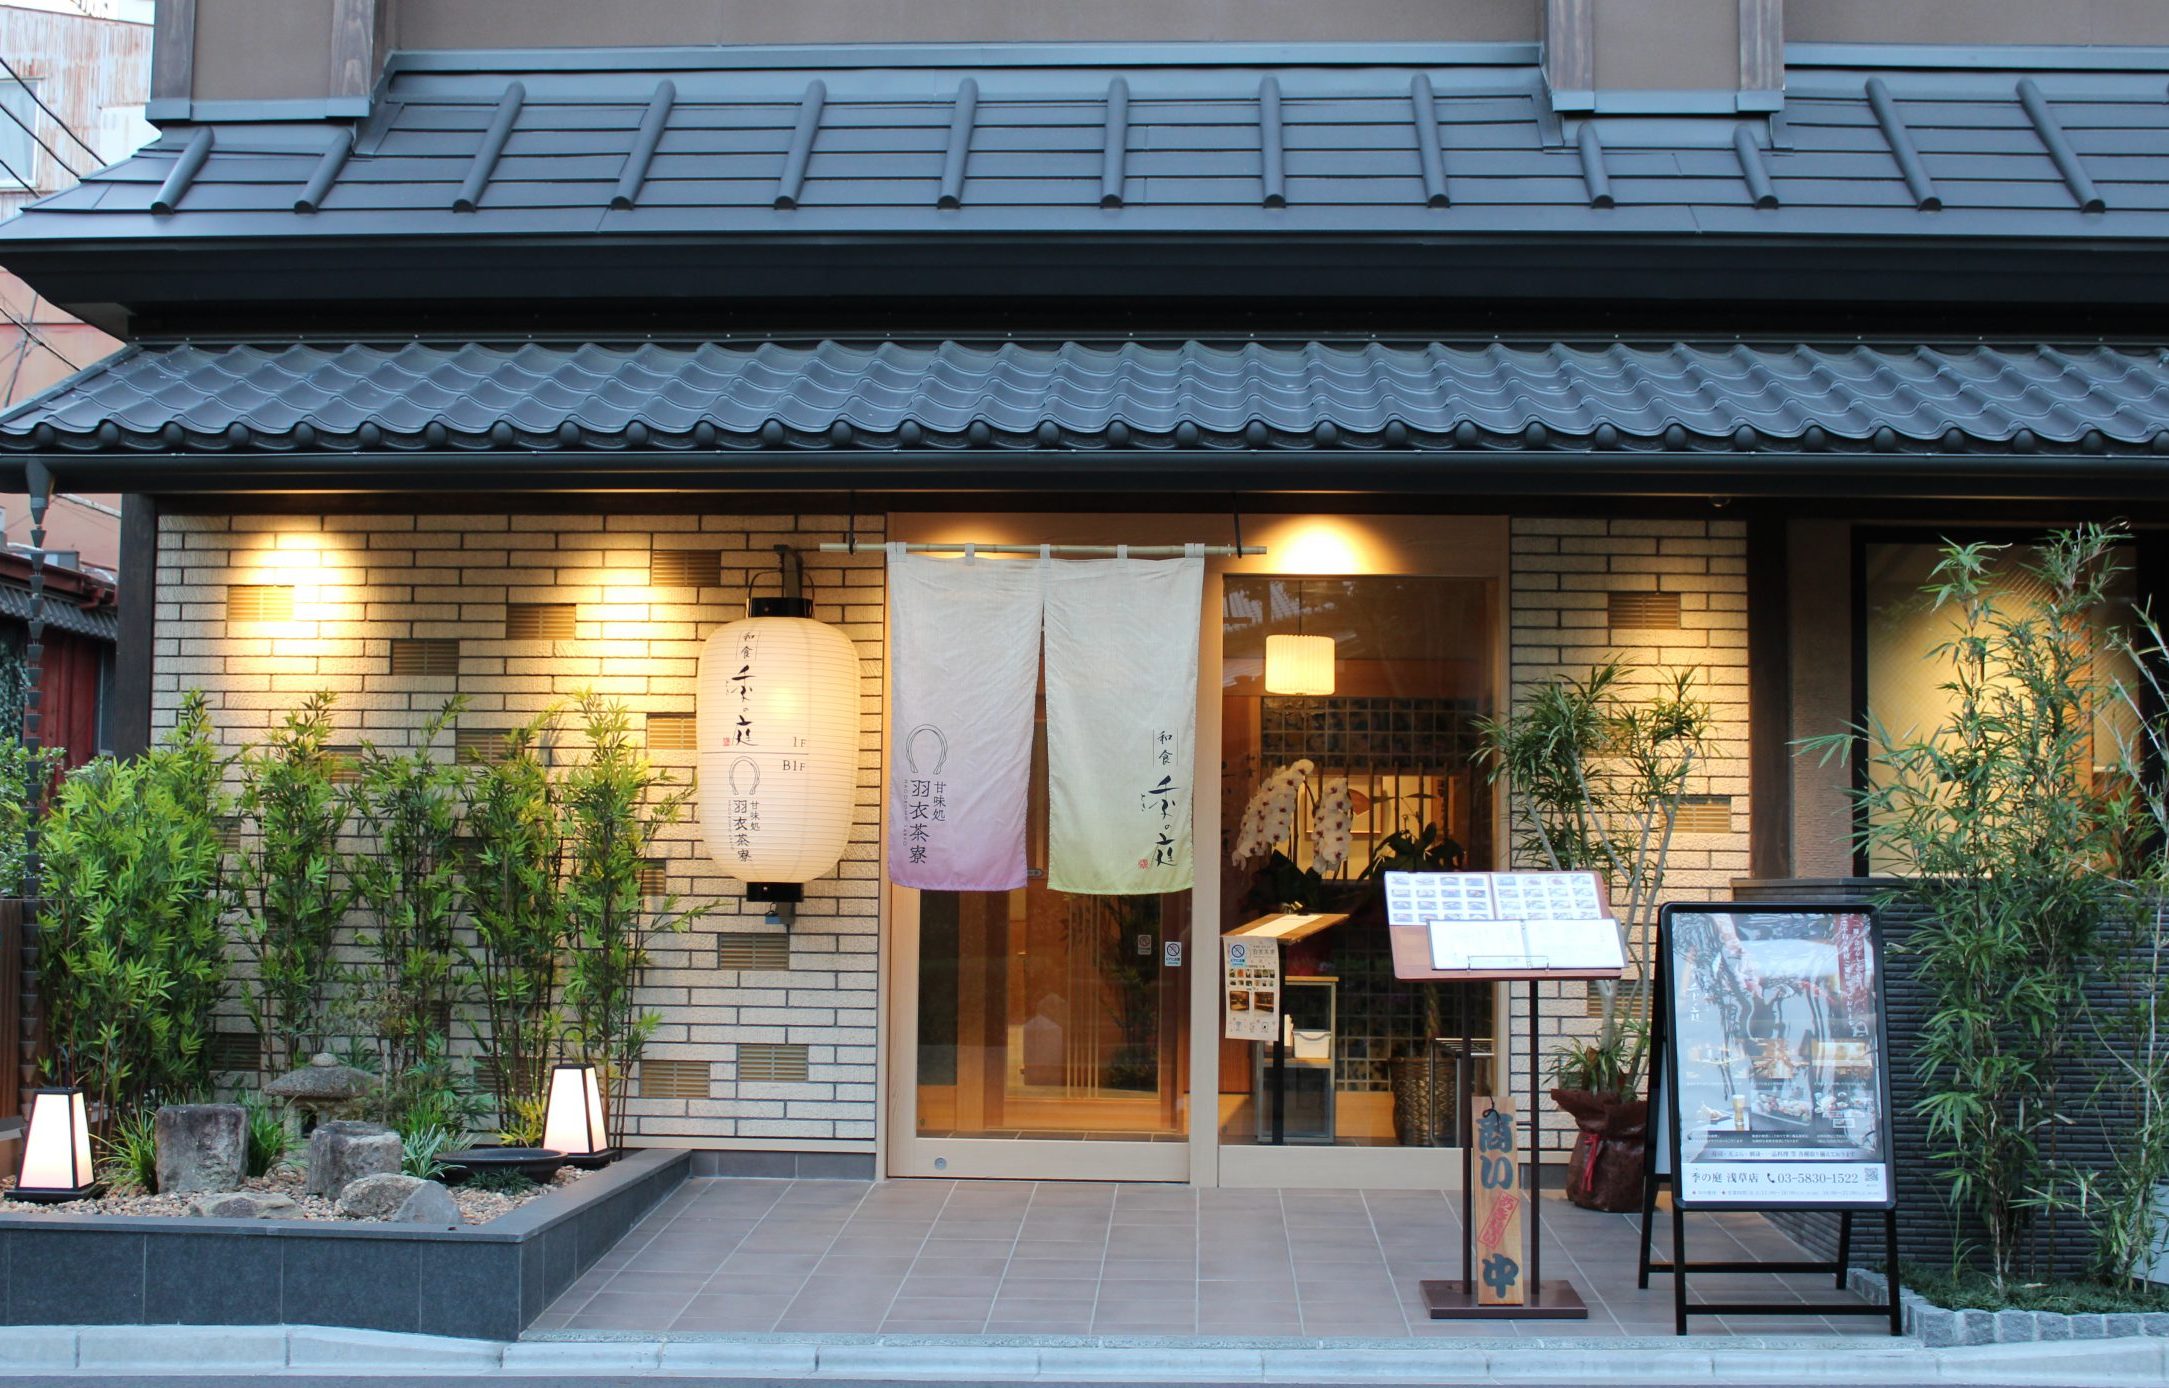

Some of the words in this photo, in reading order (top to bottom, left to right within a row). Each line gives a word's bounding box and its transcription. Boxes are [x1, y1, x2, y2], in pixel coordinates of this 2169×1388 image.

[741, 632, 755, 659] 和食
[792, 736, 807, 748] 1F
[1157, 730, 1173, 766] 和食
[782, 759, 806, 771] B1F
[750, 799, 761, 832] 甘味処
[933, 780, 947, 822] 甘味処
[733, 799, 752, 863] 羽衣茶寮
[909, 779, 931, 865] 羽衣茶寮
[1691, 1171, 1723, 1184] 季の庭
[1726, 1171, 1759, 1184] 浅草店
[1777, 1172, 1859, 1184] 03-5830-1522
